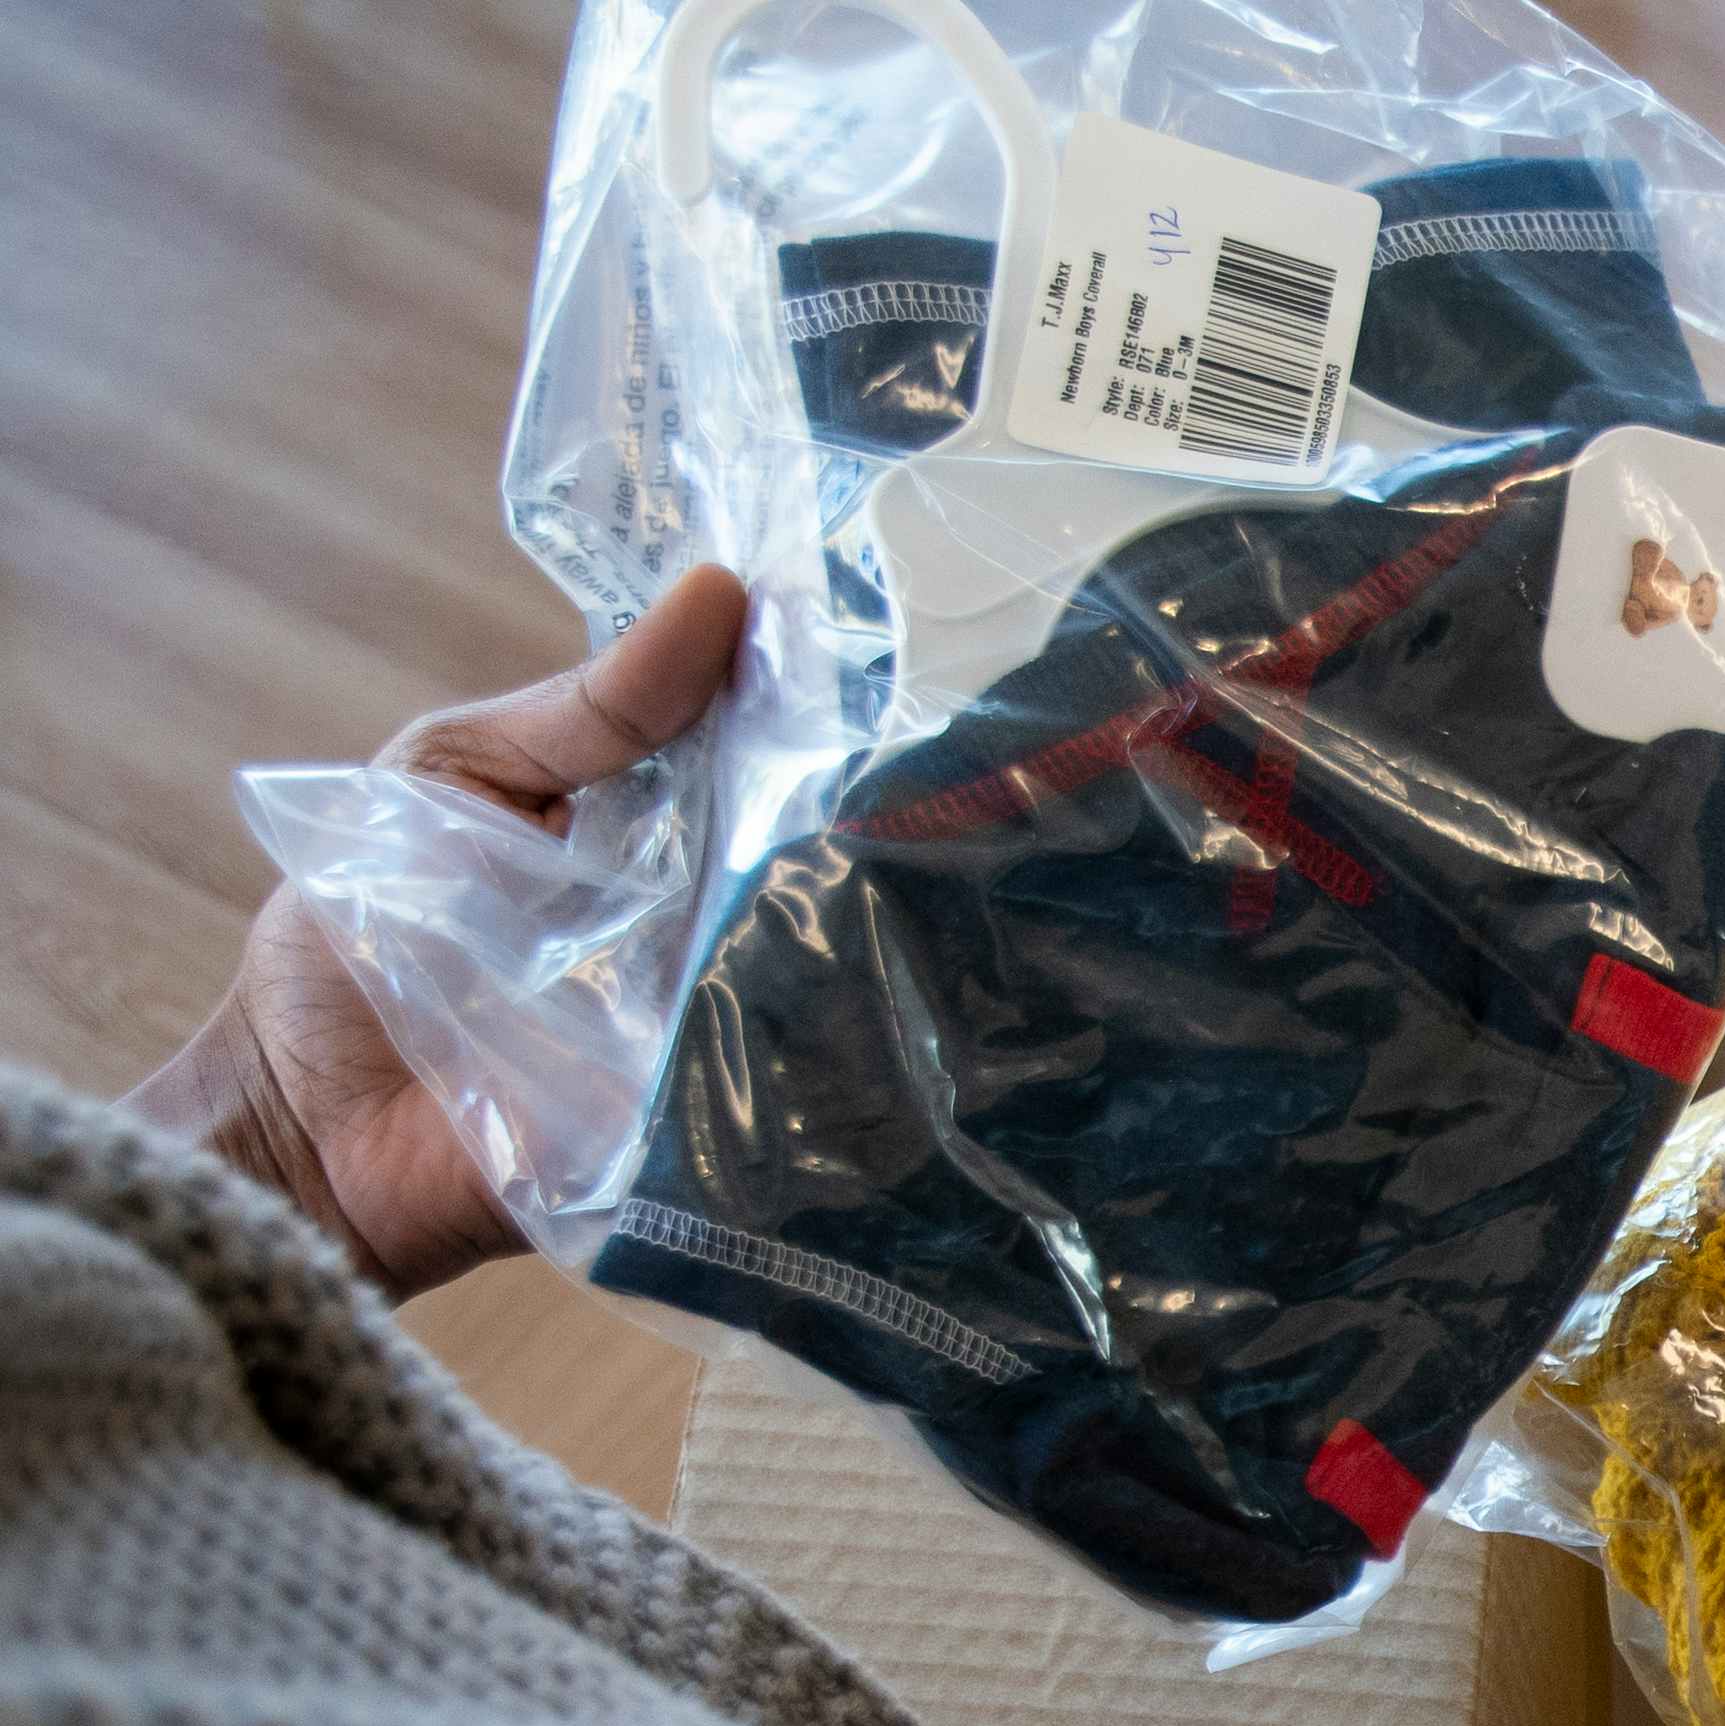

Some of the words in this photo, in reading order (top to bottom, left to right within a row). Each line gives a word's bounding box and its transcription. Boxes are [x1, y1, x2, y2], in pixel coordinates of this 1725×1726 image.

[1041, 261, 1072, 328] T.J.Maxx
[1082, 251, 1107, 303] Coverall
[1074, 305, 1097, 338] Boys
[1060, 342, 1087, 404] Newborn
[1102, 376, 1125, 416] Style:
[1118, 292, 1148, 370] RSE146B02
[1154, 347, 1175, 378] Blue
[621, 374, 648, 414] de
[1123, 384, 1146, 421] Dept:
[1135, 347, 1155, 374] 071
[1143, 386, 1166, 426] Color:
[1162, 399, 1184, 432] Size:
